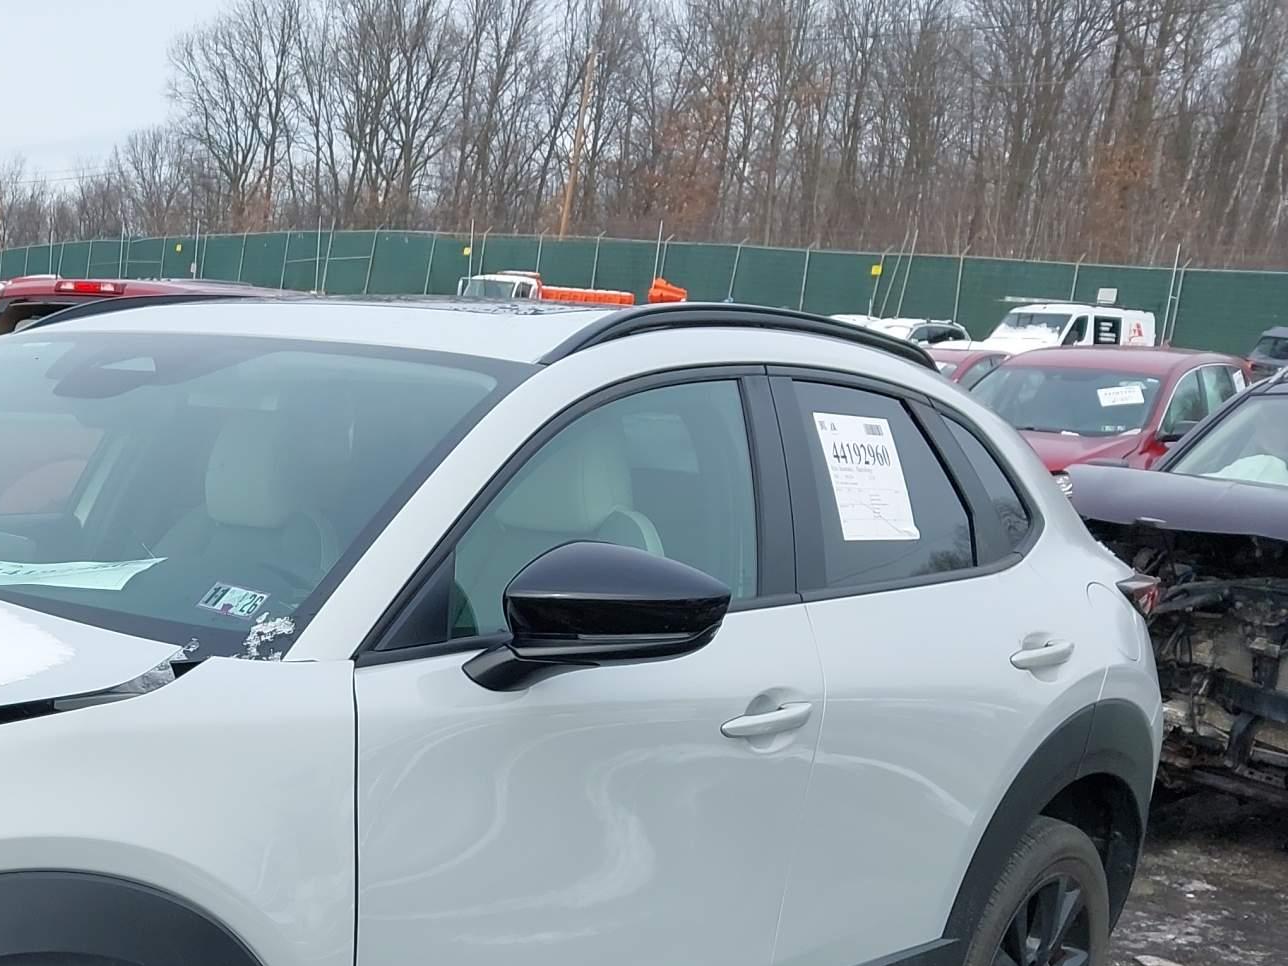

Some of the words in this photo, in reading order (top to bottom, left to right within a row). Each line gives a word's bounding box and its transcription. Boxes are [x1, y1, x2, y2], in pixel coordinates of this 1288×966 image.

[832, 441, 891, 467] 44192960
[205, 586, 231, 607] 11
[238, 593, 265, 614] 26
